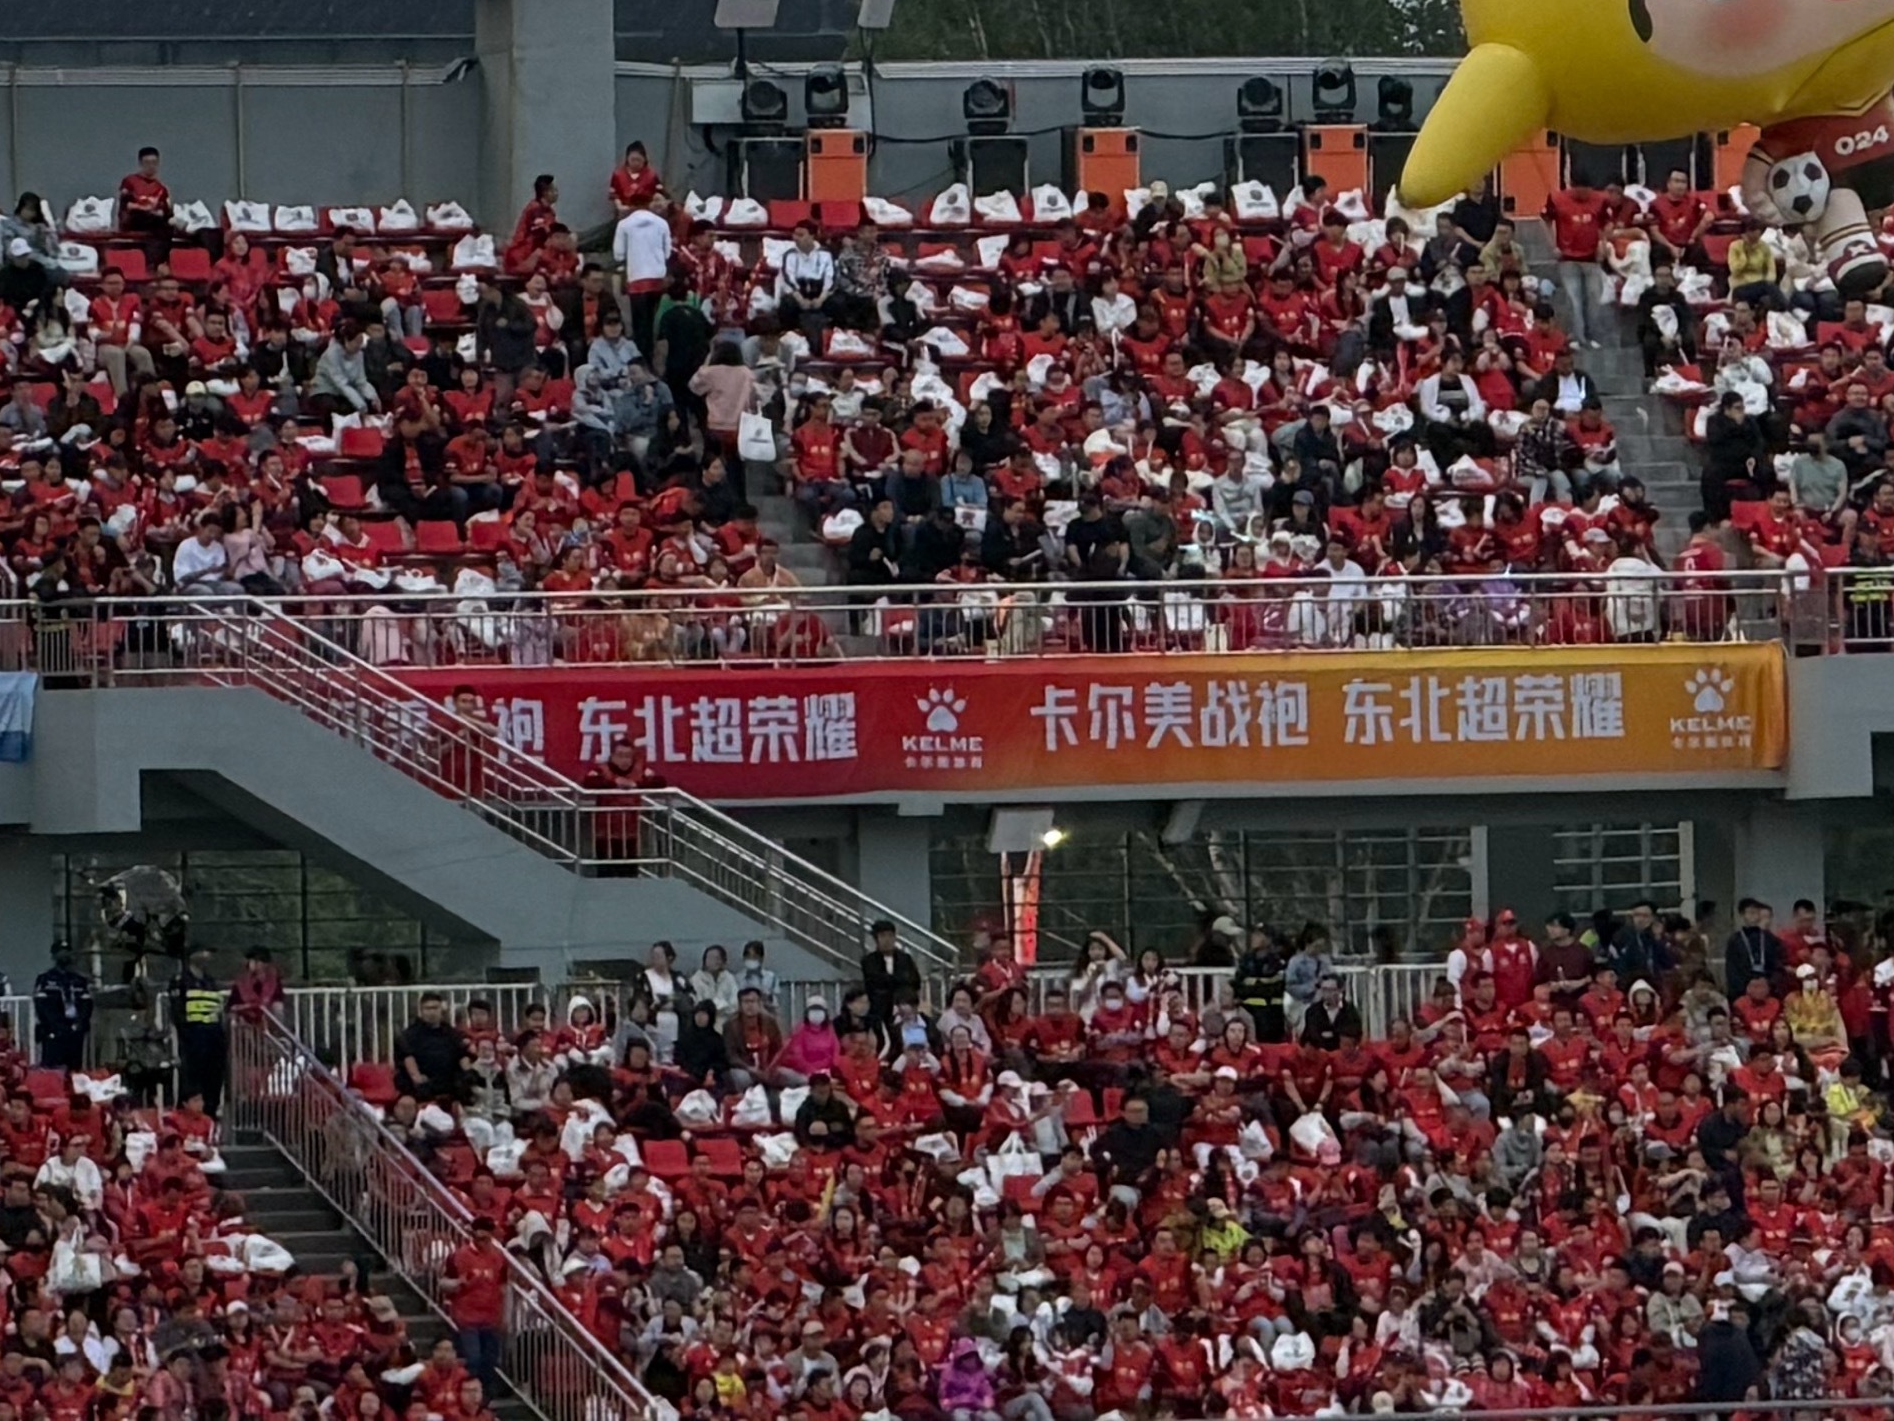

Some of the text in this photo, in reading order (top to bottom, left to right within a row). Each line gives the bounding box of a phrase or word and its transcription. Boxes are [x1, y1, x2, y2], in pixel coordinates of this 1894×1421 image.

[1835, 125, 1889, 155] 024
[1030, 669, 1626, 752] 卡尔美战袍 东北超荣耀
[1669, 716, 1753, 734] KELME
[577, 691, 859, 765] 东北超荣耀
[901, 735, 984, 752] KELME
